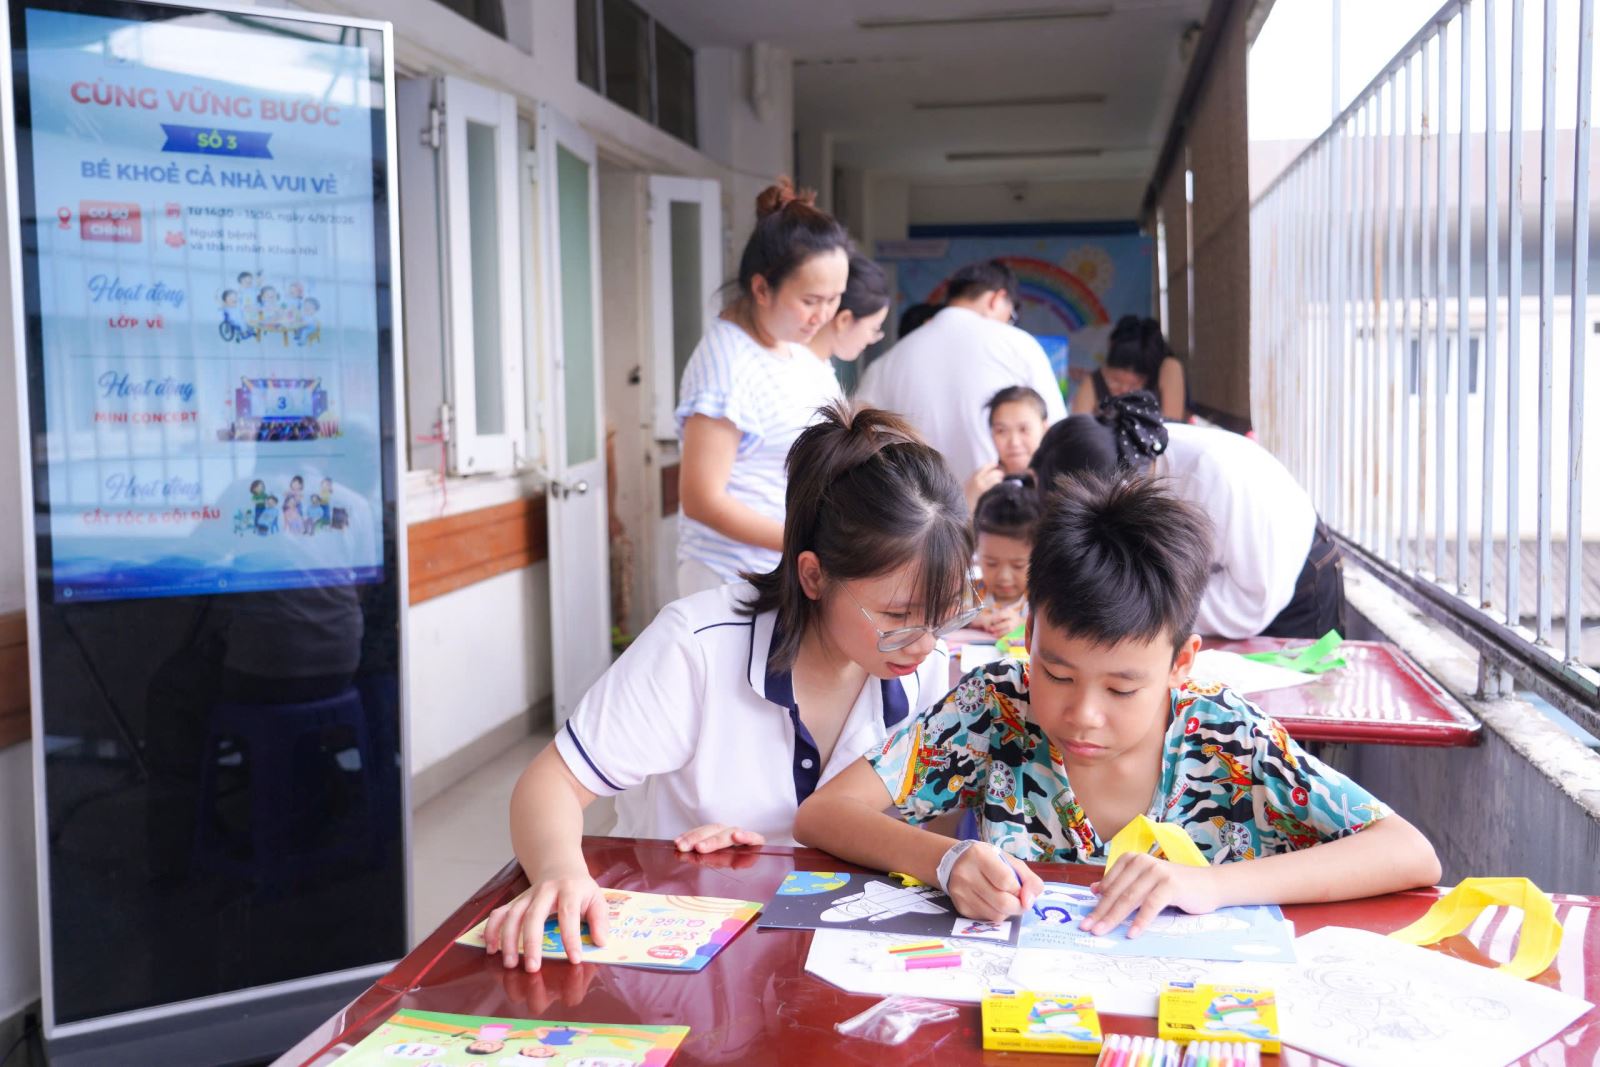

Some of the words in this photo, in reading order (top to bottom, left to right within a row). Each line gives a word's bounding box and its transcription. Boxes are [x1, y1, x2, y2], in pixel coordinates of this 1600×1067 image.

[70, 78, 159, 110] CÙNG
[166, 85, 254, 119] VỮNG
[260, 98, 343, 126] BƯỚC
[197, 128, 223, 150] SỐ
[226, 135, 238, 150] 3
[80, 158, 111, 180] BÉ
[116, 161, 181, 184] KHOẺ
[185, 166, 216, 187] CẢ
[221, 168, 268, 191] NHÀ
[271, 174, 307, 193] VUI
[310, 172, 338, 194] VẺ
[88, 274, 142, 306] Hoạt
[145, 280, 185, 309] động
[109, 316, 139, 329] LỚP
[97, 370, 152, 400] Hoạt
[277, 396, 287, 409] 3
[94, 411, 128, 424] MINI
[131, 411, 198, 425] CONCERT
